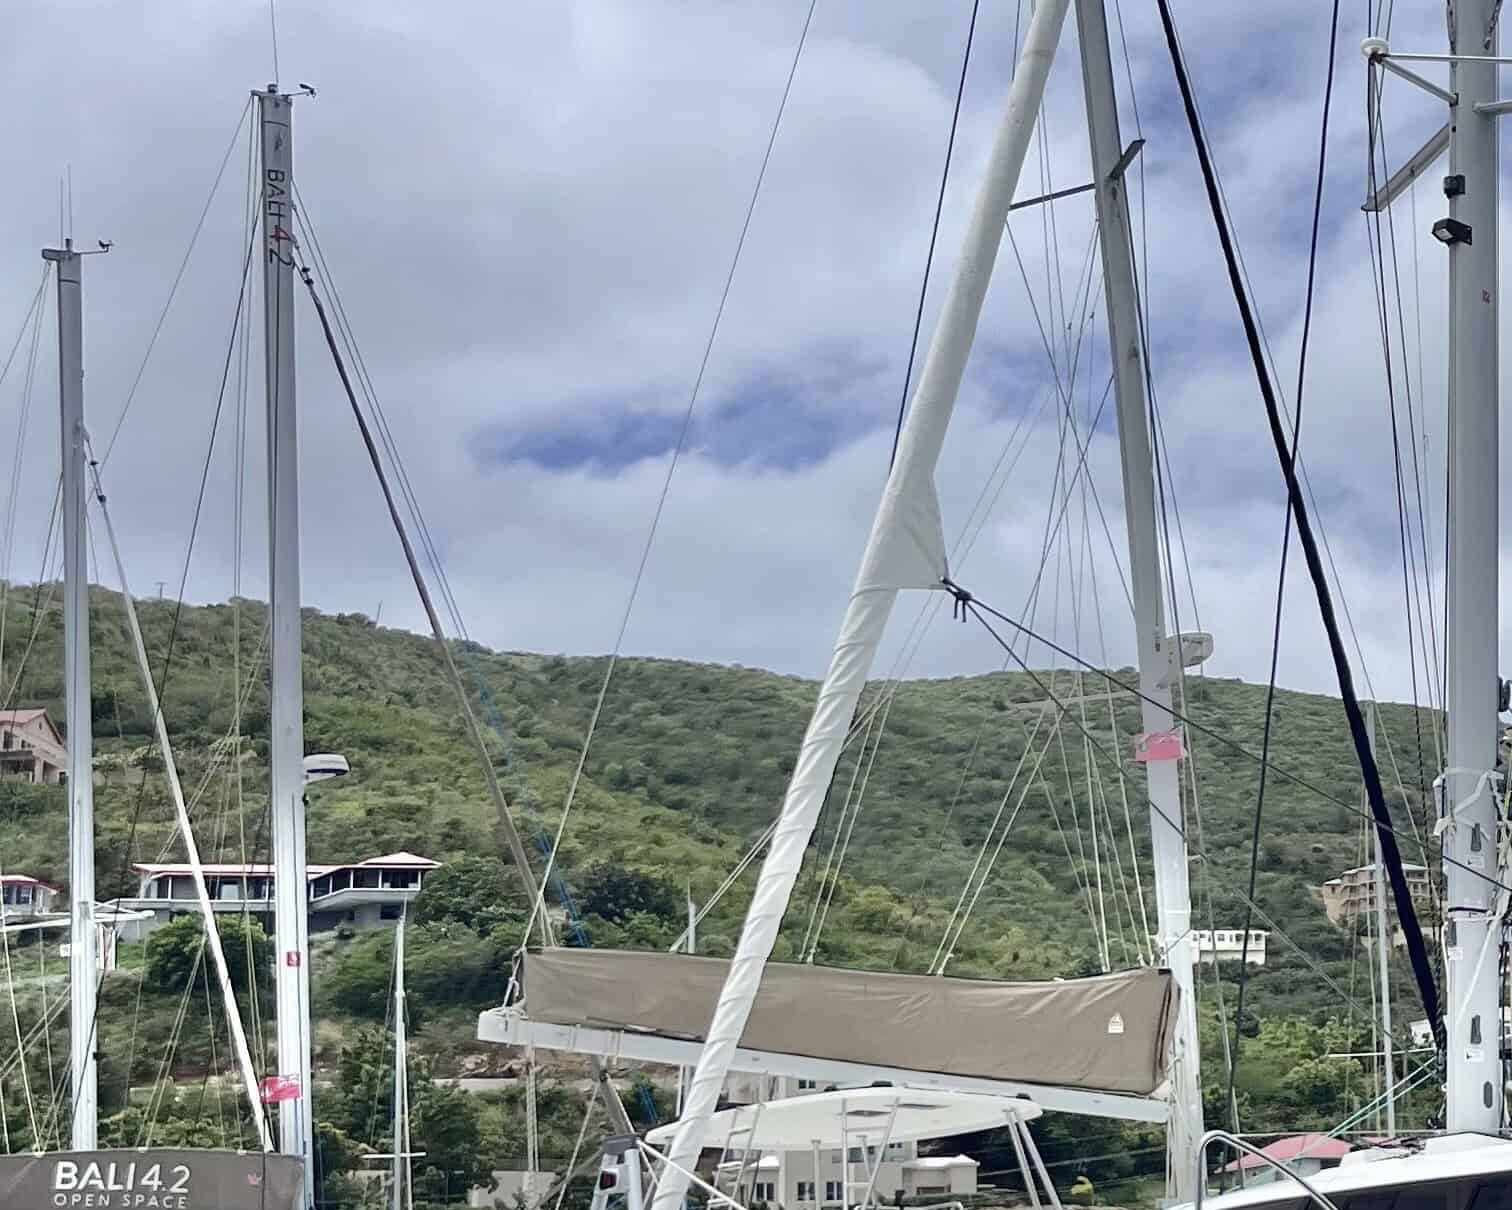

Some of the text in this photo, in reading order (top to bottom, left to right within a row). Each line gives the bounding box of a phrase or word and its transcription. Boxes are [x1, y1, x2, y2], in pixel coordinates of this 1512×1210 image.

[267, 169, 286, 217] BALI
[54, 1161, 192, 1193] BALI 4.2
[54, 1193, 188, 1209] OPEN SPACE
